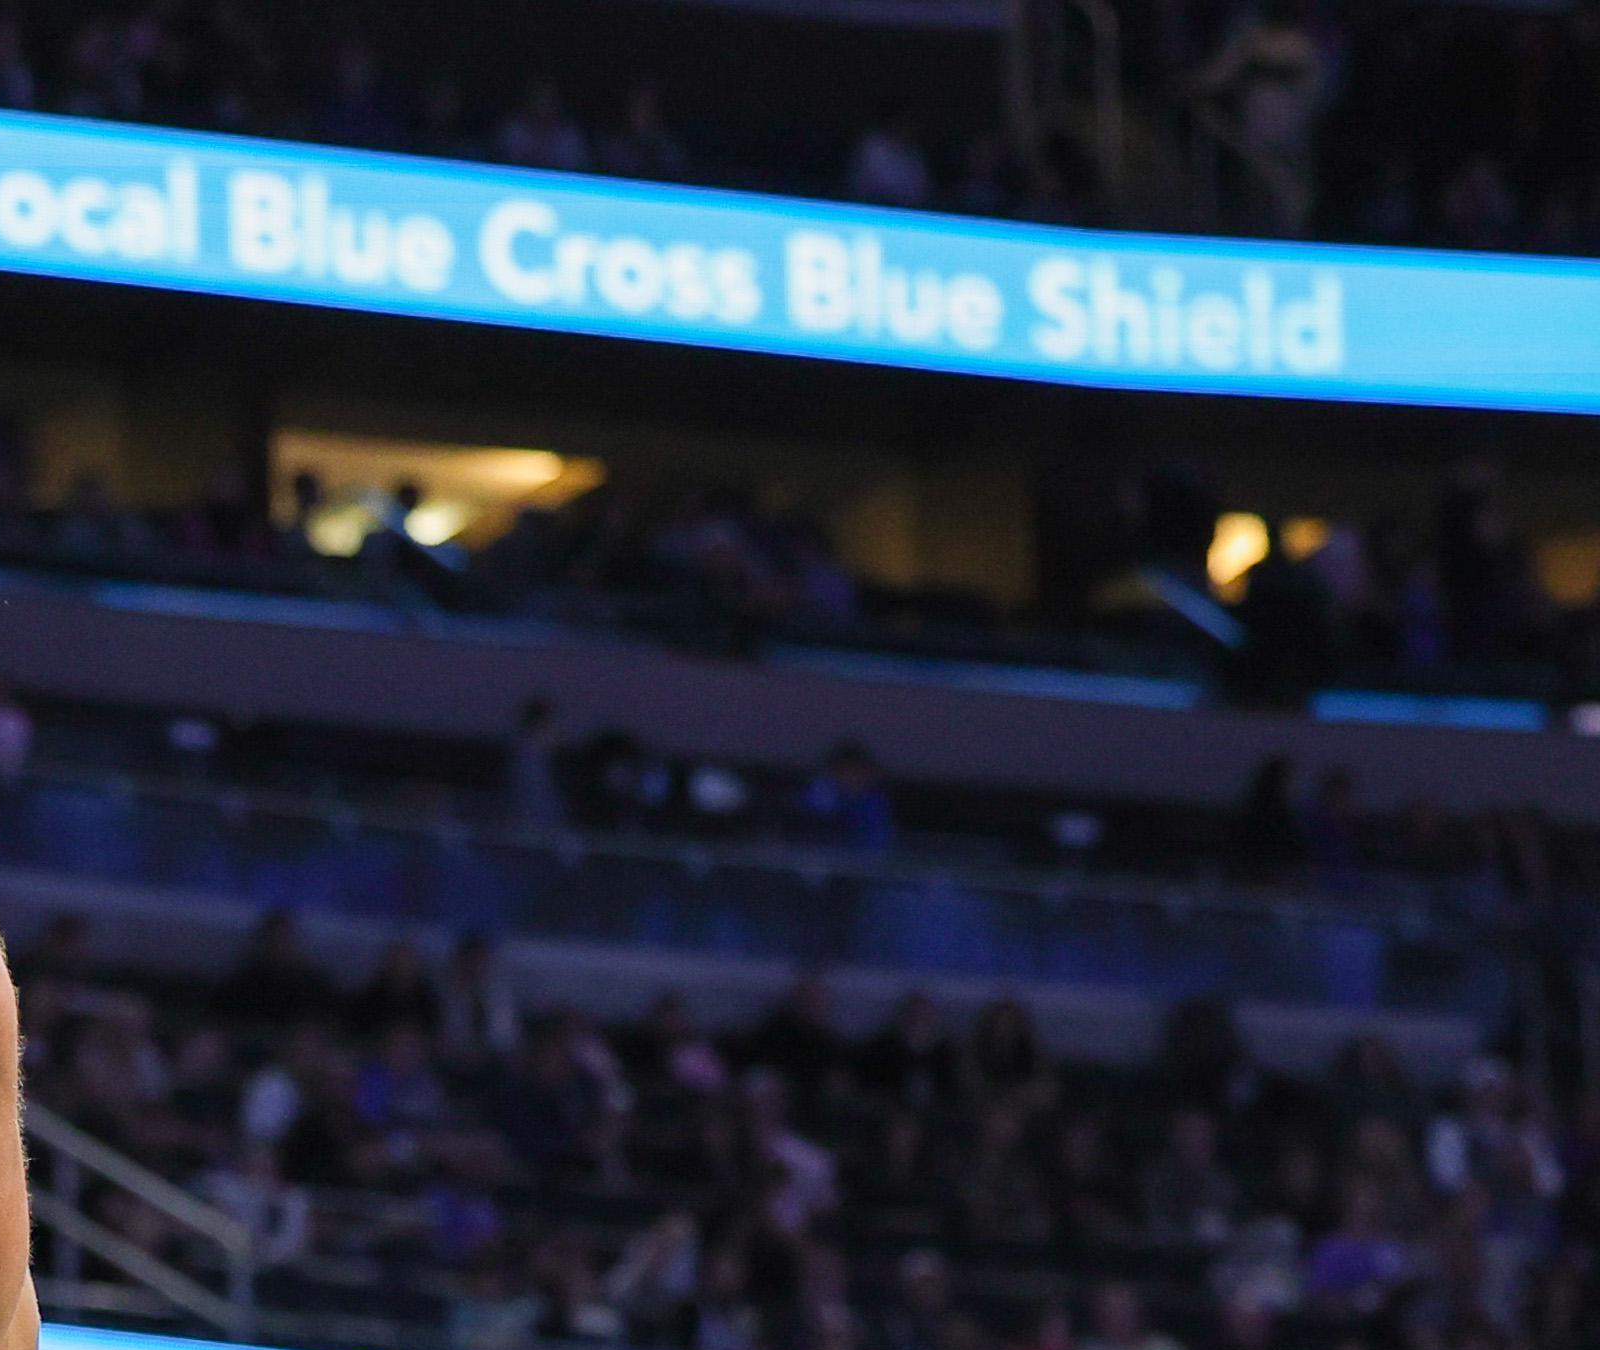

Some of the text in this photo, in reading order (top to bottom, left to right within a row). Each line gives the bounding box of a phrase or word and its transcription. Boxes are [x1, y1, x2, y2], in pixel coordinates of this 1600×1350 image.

[228, 170, 455, 293] Blue
[479, 199, 763, 325] Cross
[786, 230, 1004, 350] Blue
[1027, 252, 1345, 376] Shield
